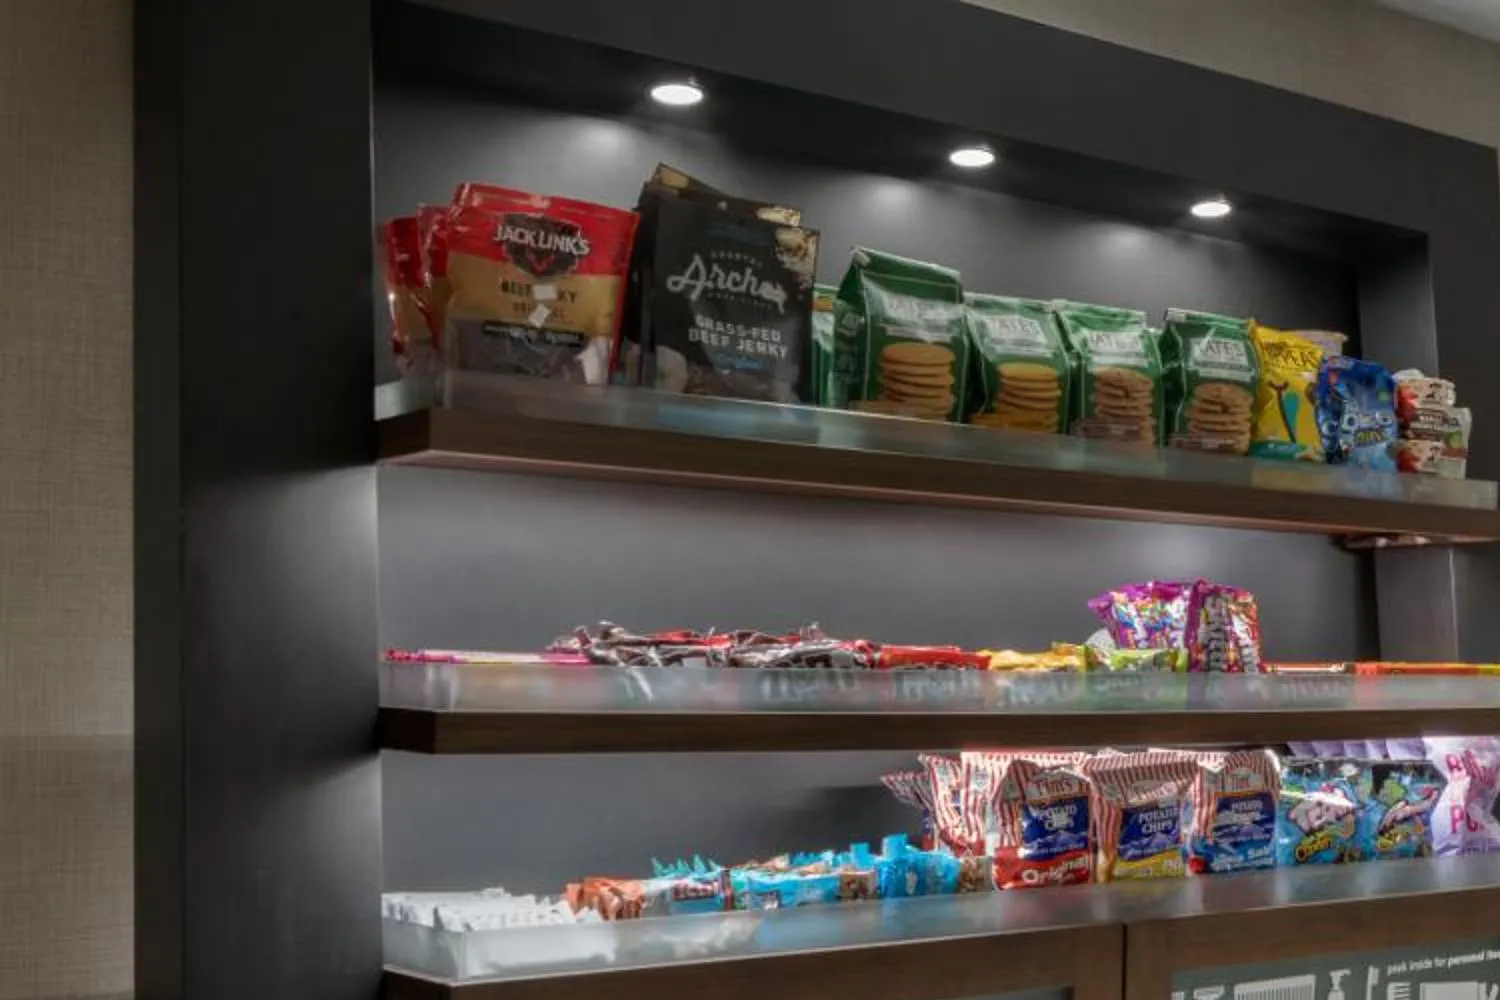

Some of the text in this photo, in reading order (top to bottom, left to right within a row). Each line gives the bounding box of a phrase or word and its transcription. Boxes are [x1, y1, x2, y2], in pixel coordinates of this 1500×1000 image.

[493, 223, 591, 256] JACK LINK'S
[736, 339, 787, 359] JERKY
